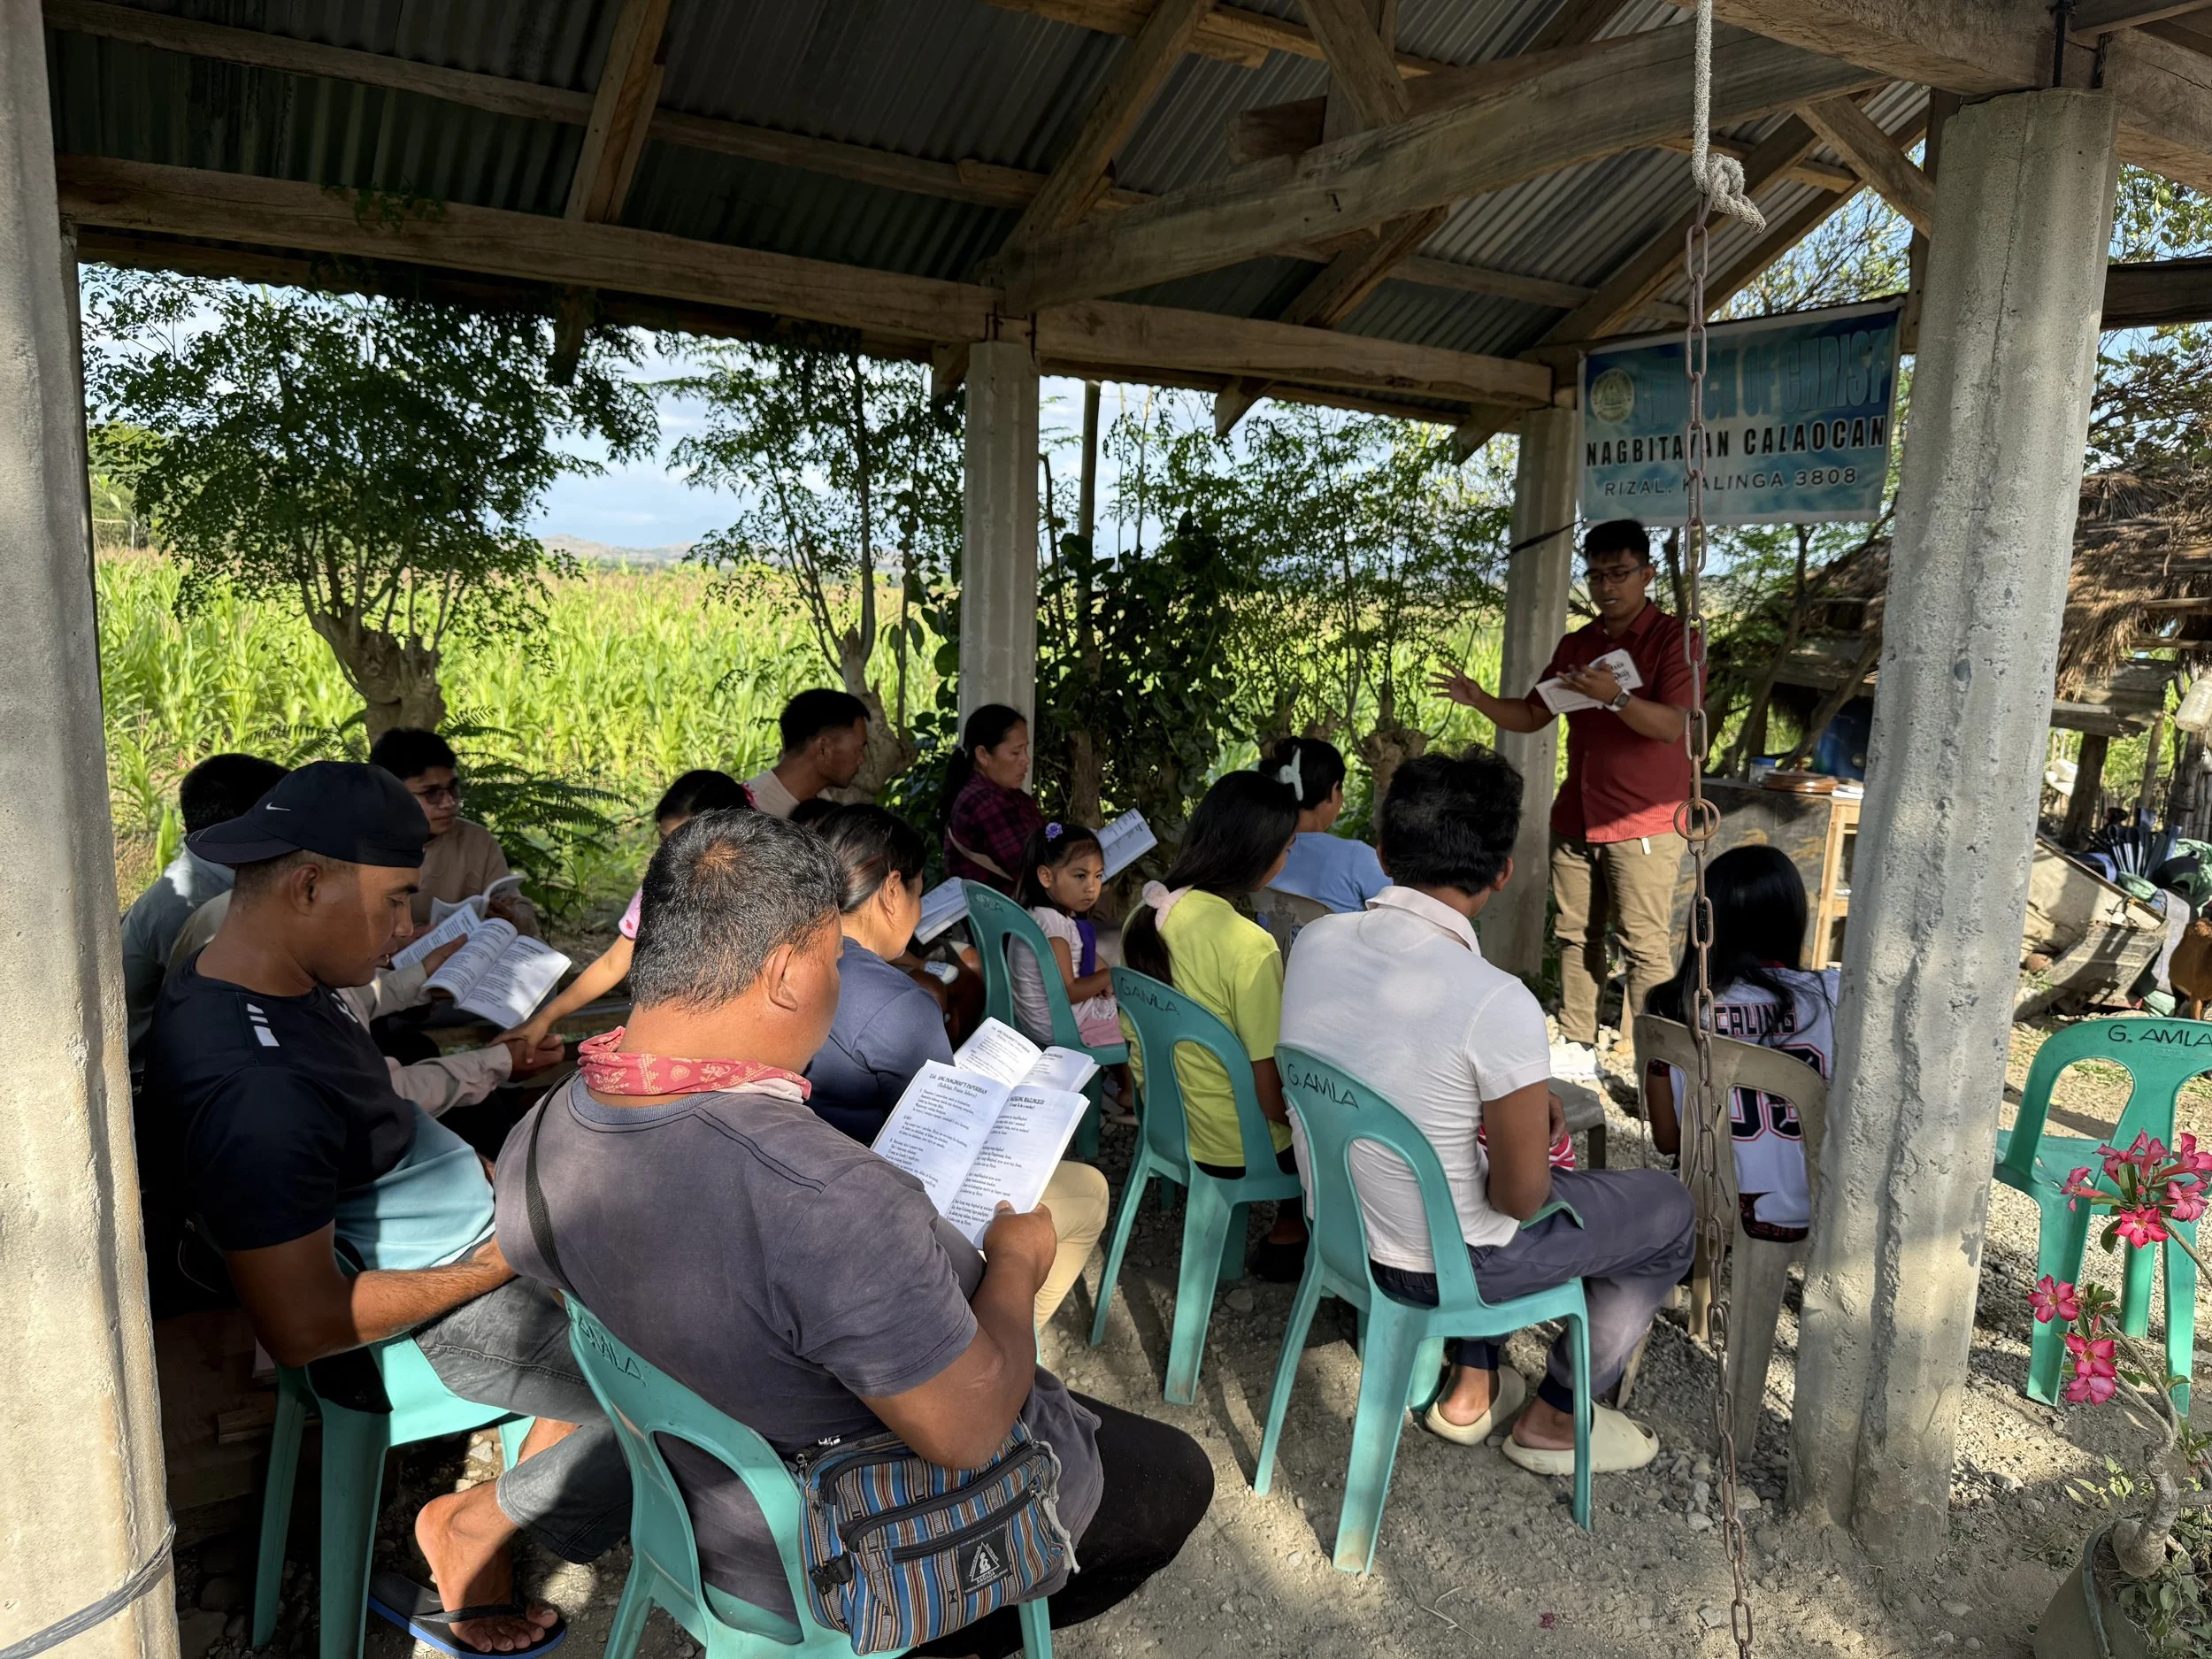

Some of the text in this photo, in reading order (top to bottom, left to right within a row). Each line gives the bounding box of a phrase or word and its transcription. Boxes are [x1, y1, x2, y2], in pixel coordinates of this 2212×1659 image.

[1781, 328, 1890, 414] CHRIST
[1586, 417, 1885, 467] NAGBITAYAN CALAOCAN
[1795, 468, 1856, 486] 3808
[2139, 1028, 2212, 1048] AMLA
